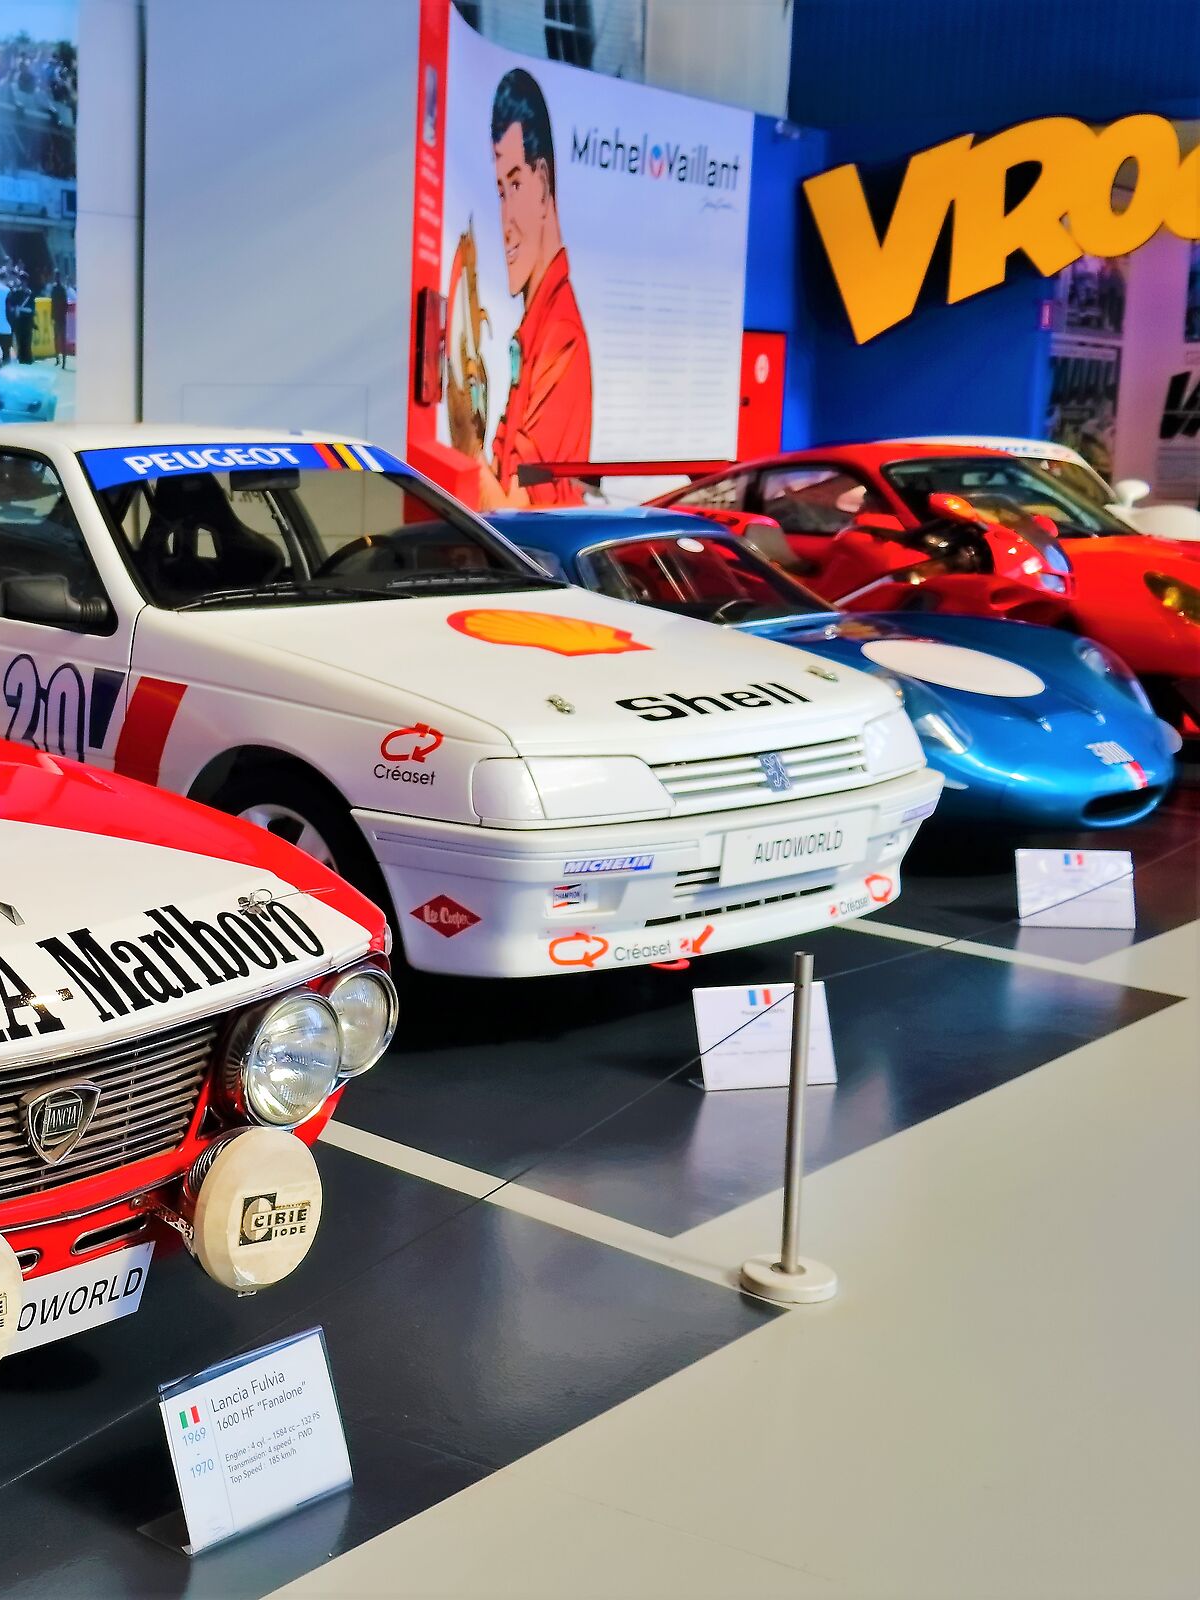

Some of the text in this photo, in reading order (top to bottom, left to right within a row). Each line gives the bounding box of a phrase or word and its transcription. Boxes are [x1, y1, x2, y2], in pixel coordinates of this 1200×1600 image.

[571, 124, 740, 191] Michel Vaillant
[123, 446, 300, 476] PEUGEOT
[3, 653, 86, 763] 20
[615, 682, 813, 722] Shell
[373, 763, 436, 786] Créaset
[754, 829, 844, 865] AUTOWORLD
[564, 855, 654, 874] MICHELIN
[613, 939, 672, 961] Créaset
[254, 1208, 308, 1228] CIBIE
[17, 1267, 144, 1332] OWORLD
[210, 1371, 286, 1413] Lancia Fulvia
[216, 1412, 240, 1431] 1600
[241, 1404, 255, 1421] HF
[272, 1426, 288, 1440] 1584
[301, 1415, 312, 1426] 132
[312, 1411, 321, 1421] PS
[182, 1427, 207, 1446] 1969
[273, 1436, 292, 1453] speed
[297, 1427, 313, 1440] FWD
[190, 1458, 214, 1479] 1970
[230, 1447, 297, 1484] Top Speed 185 km/h
